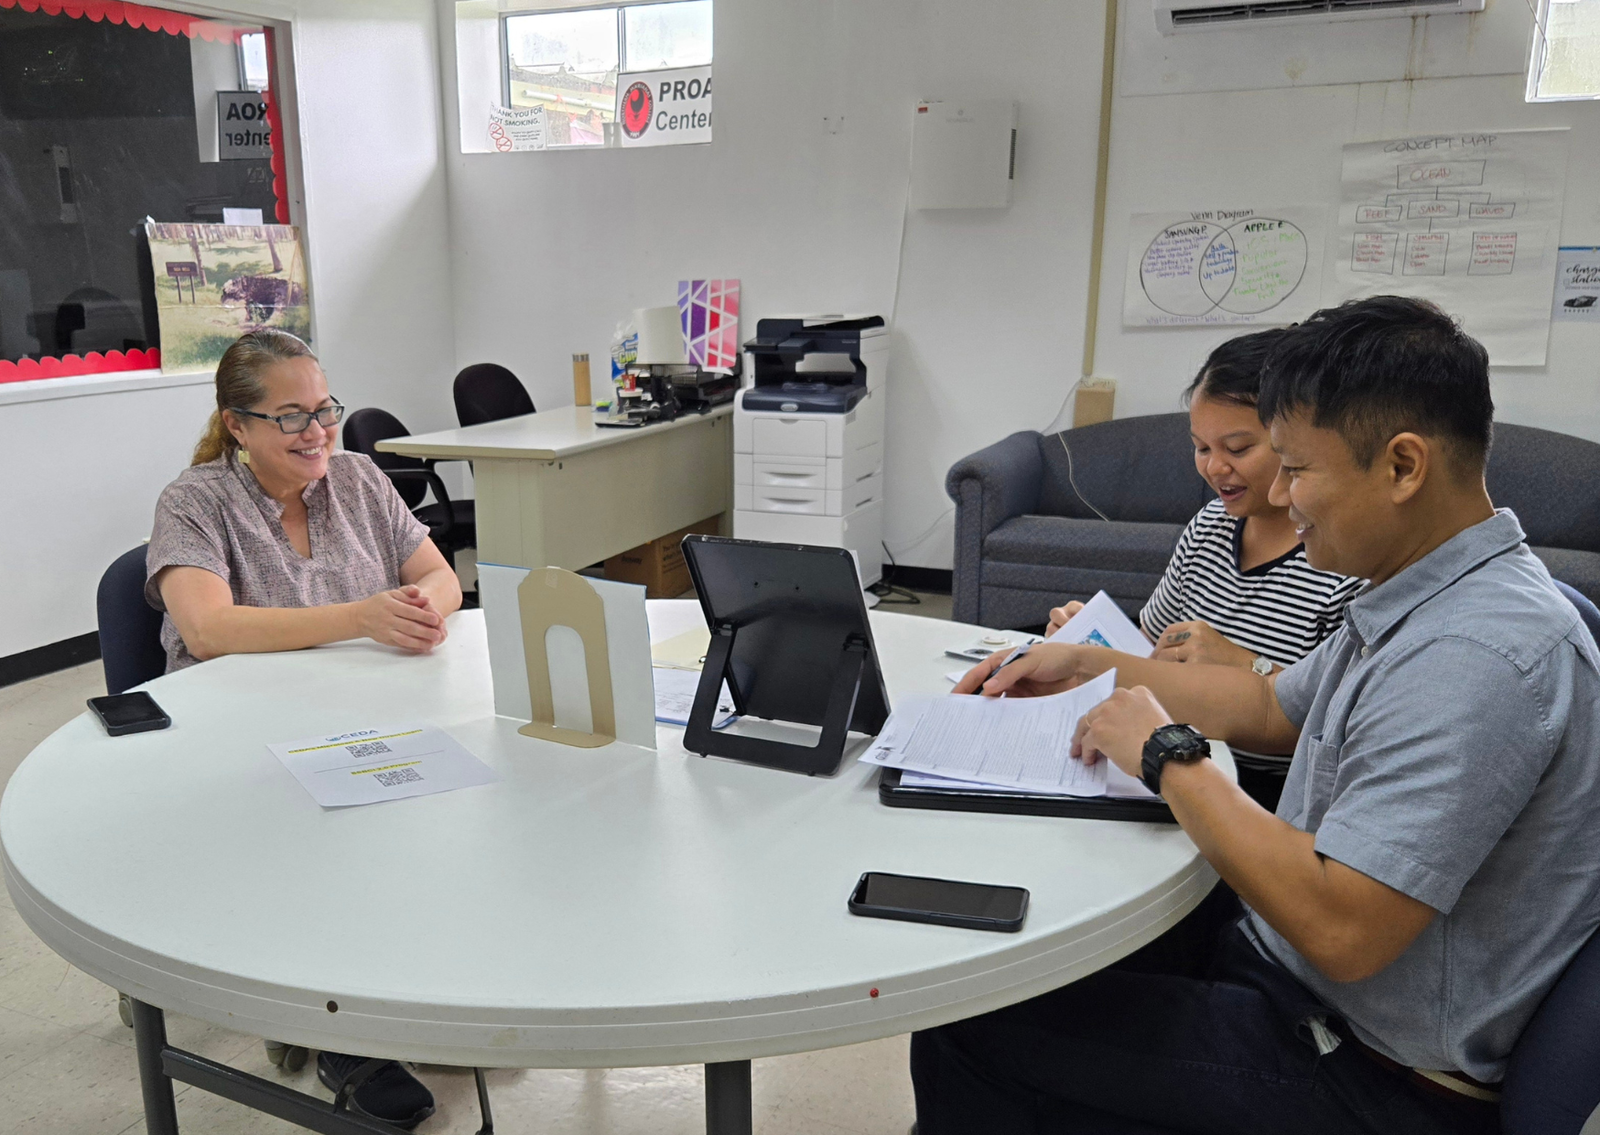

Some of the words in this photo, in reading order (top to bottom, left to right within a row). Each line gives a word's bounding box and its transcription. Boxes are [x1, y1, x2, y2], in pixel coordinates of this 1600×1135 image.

[514, 110, 530, 118] YOU
[530, 106, 543, 116] FOR
[1384, 138, 1452, 153] CONCEPT
[1461, 135, 1498, 147] MAP
[1409, 168, 1451, 182] OCEAN
[1366, 209, 1390, 219] REEF
[1418, 205, 1447, 214] SAND
[1475, 207, 1506, 216] WAVES
[1244, 222, 1275, 233] APPLE
[340, 729, 379, 739] CEDA
